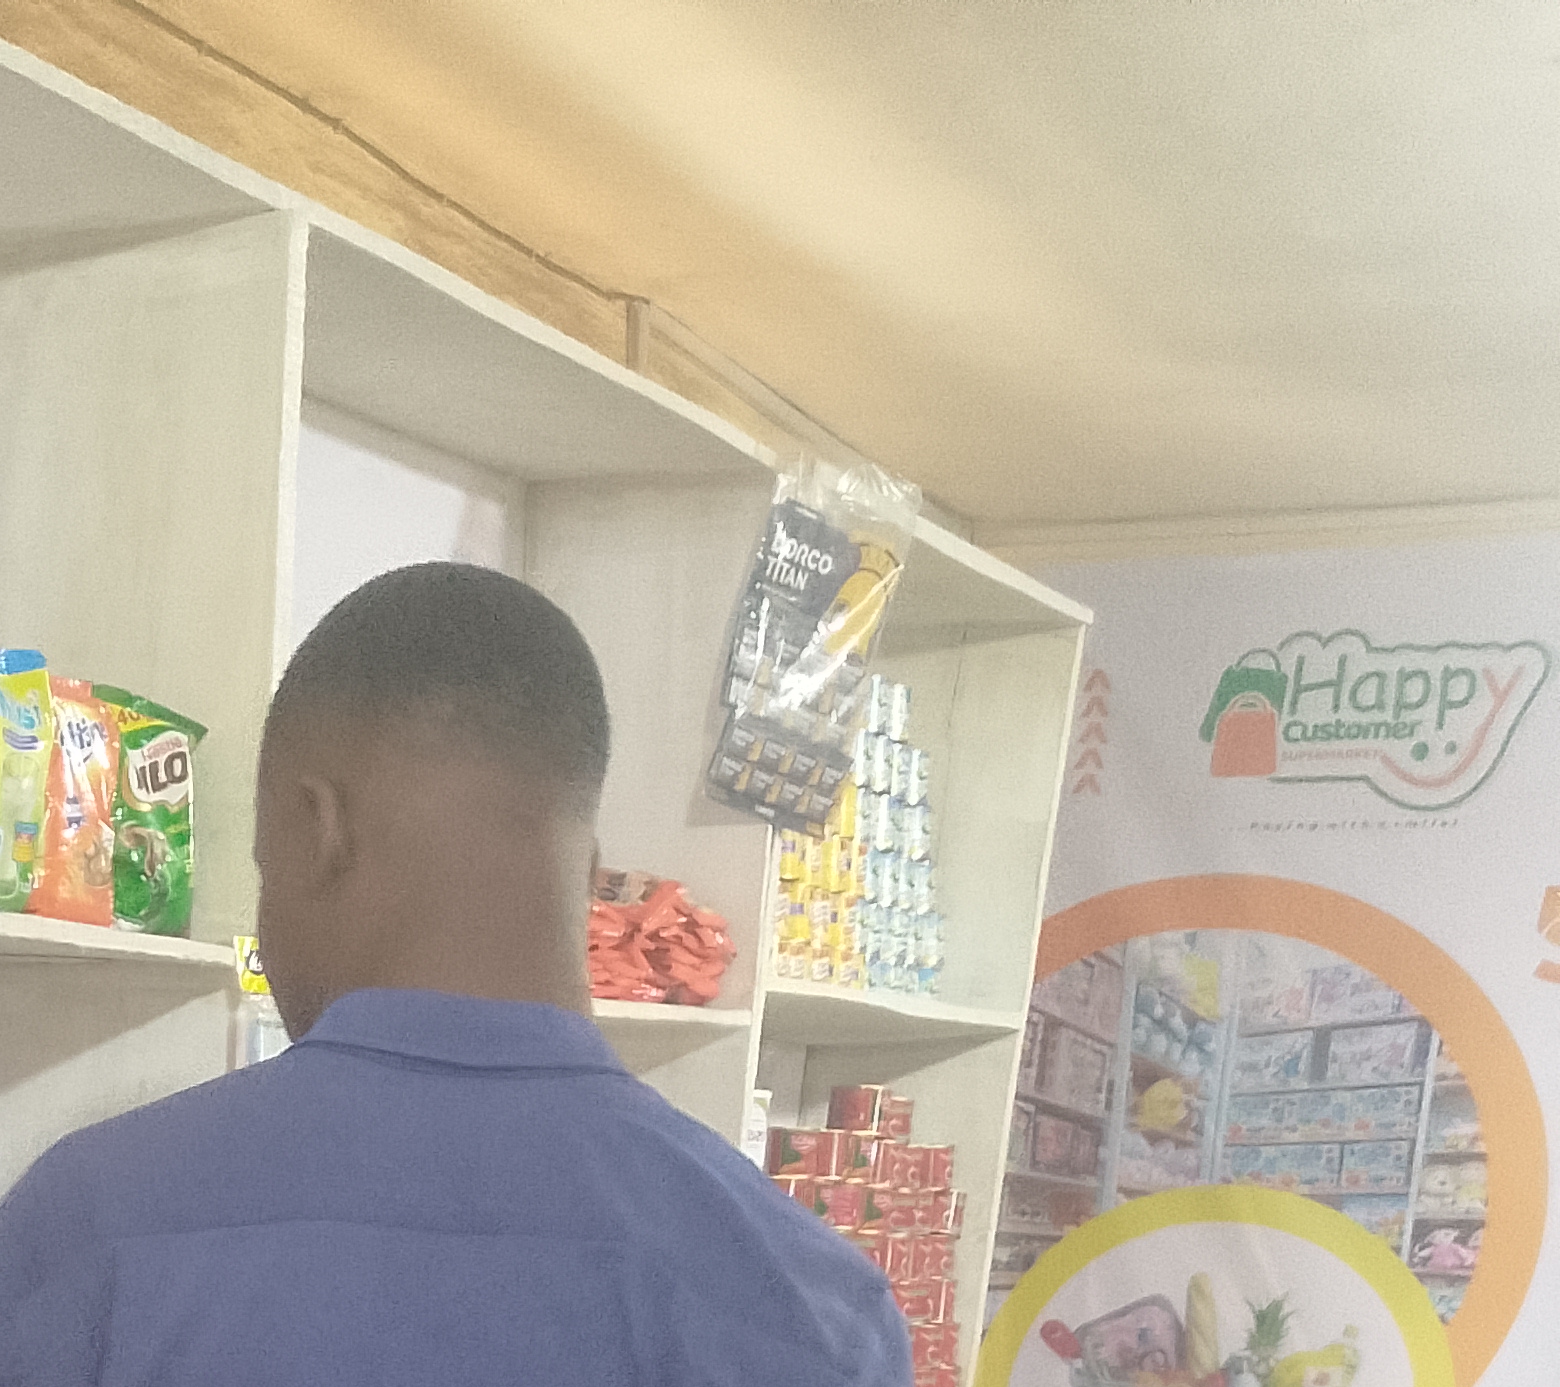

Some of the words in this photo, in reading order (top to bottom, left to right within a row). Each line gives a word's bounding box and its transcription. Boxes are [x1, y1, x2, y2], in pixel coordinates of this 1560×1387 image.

[765, 555, 810, 592] TITAN
[1288, 653, 1525, 745] Happy
[1282, 719, 1423, 743] Customer
